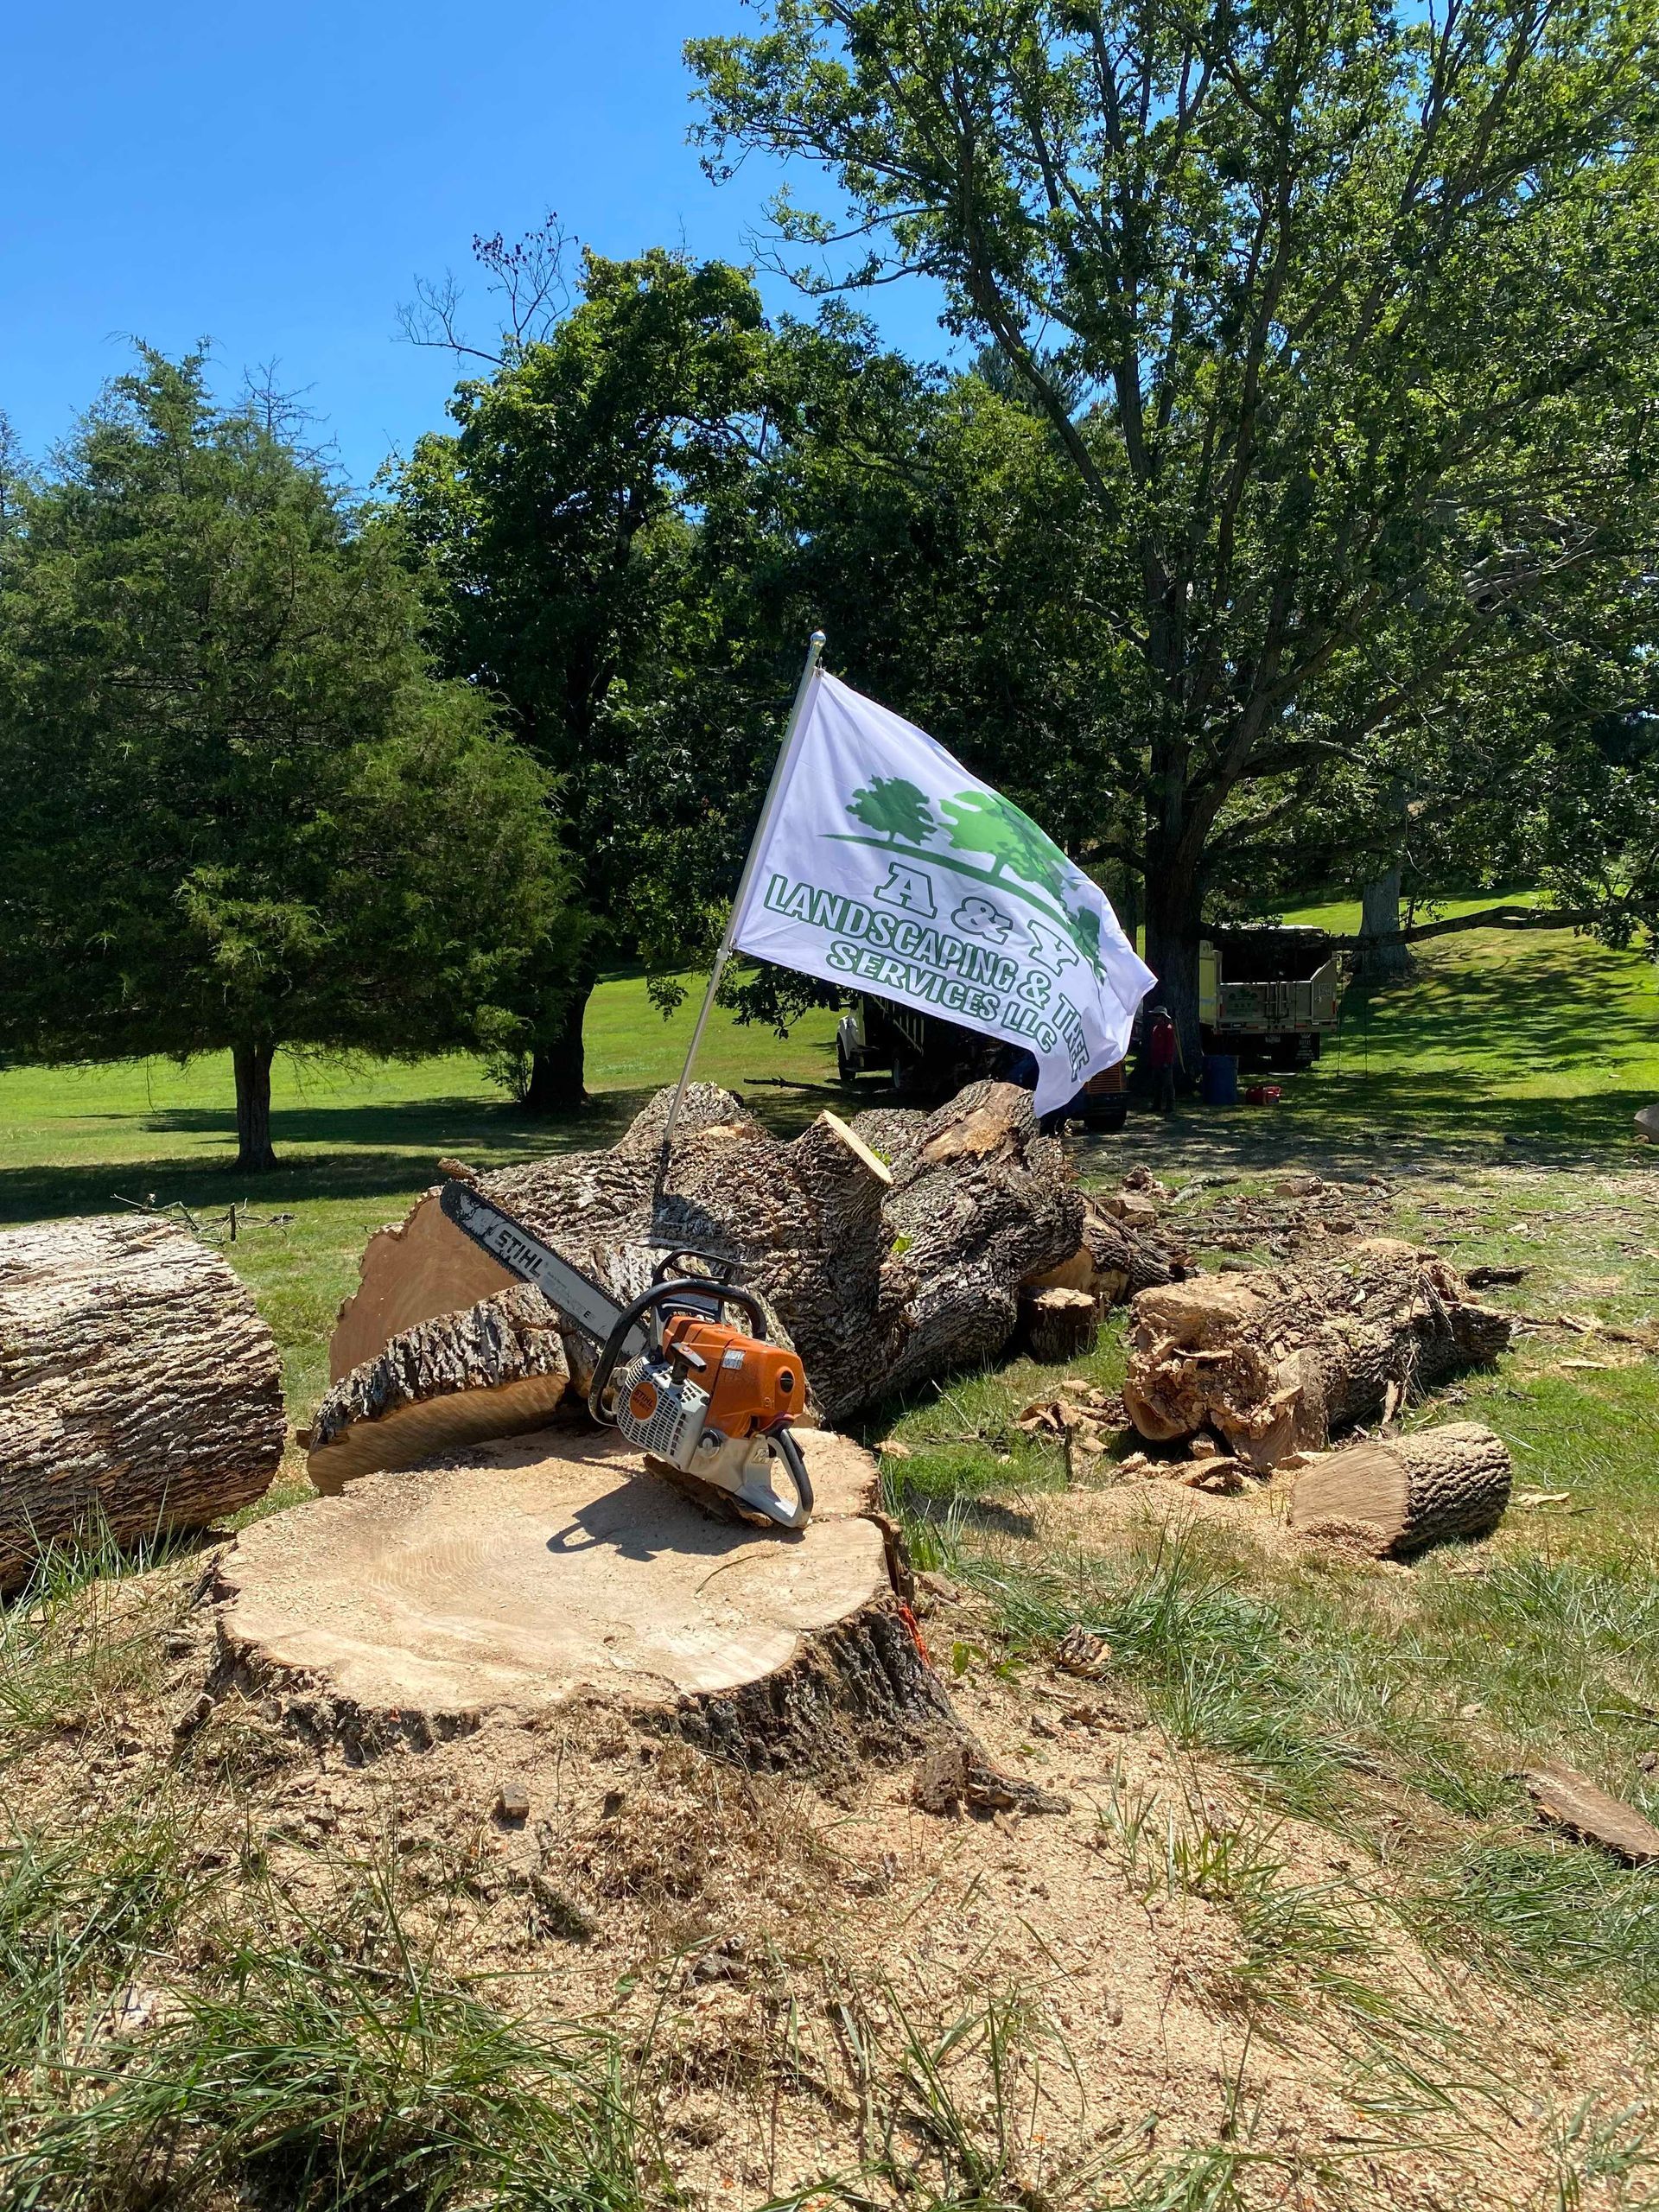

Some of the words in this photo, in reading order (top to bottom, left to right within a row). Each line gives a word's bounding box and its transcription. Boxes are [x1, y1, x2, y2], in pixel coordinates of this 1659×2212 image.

[874, 862, 938, 919] A
[950, 897, 1013, 945] &
[1028, 920, 1079, 977] Y
[764, 874, 1019, 993] LANDSCAPING
[1017, 970, 1052, 1010] &
[1052, 993, 1090, 1083] TREE
[826, 941, 1001, 1021] SERVICES
[1001, 1001, 1058, 1053] LLC
[495, 1230, 543, 1278] STIHL
[634, 1389, 653, 1408] STIHL
